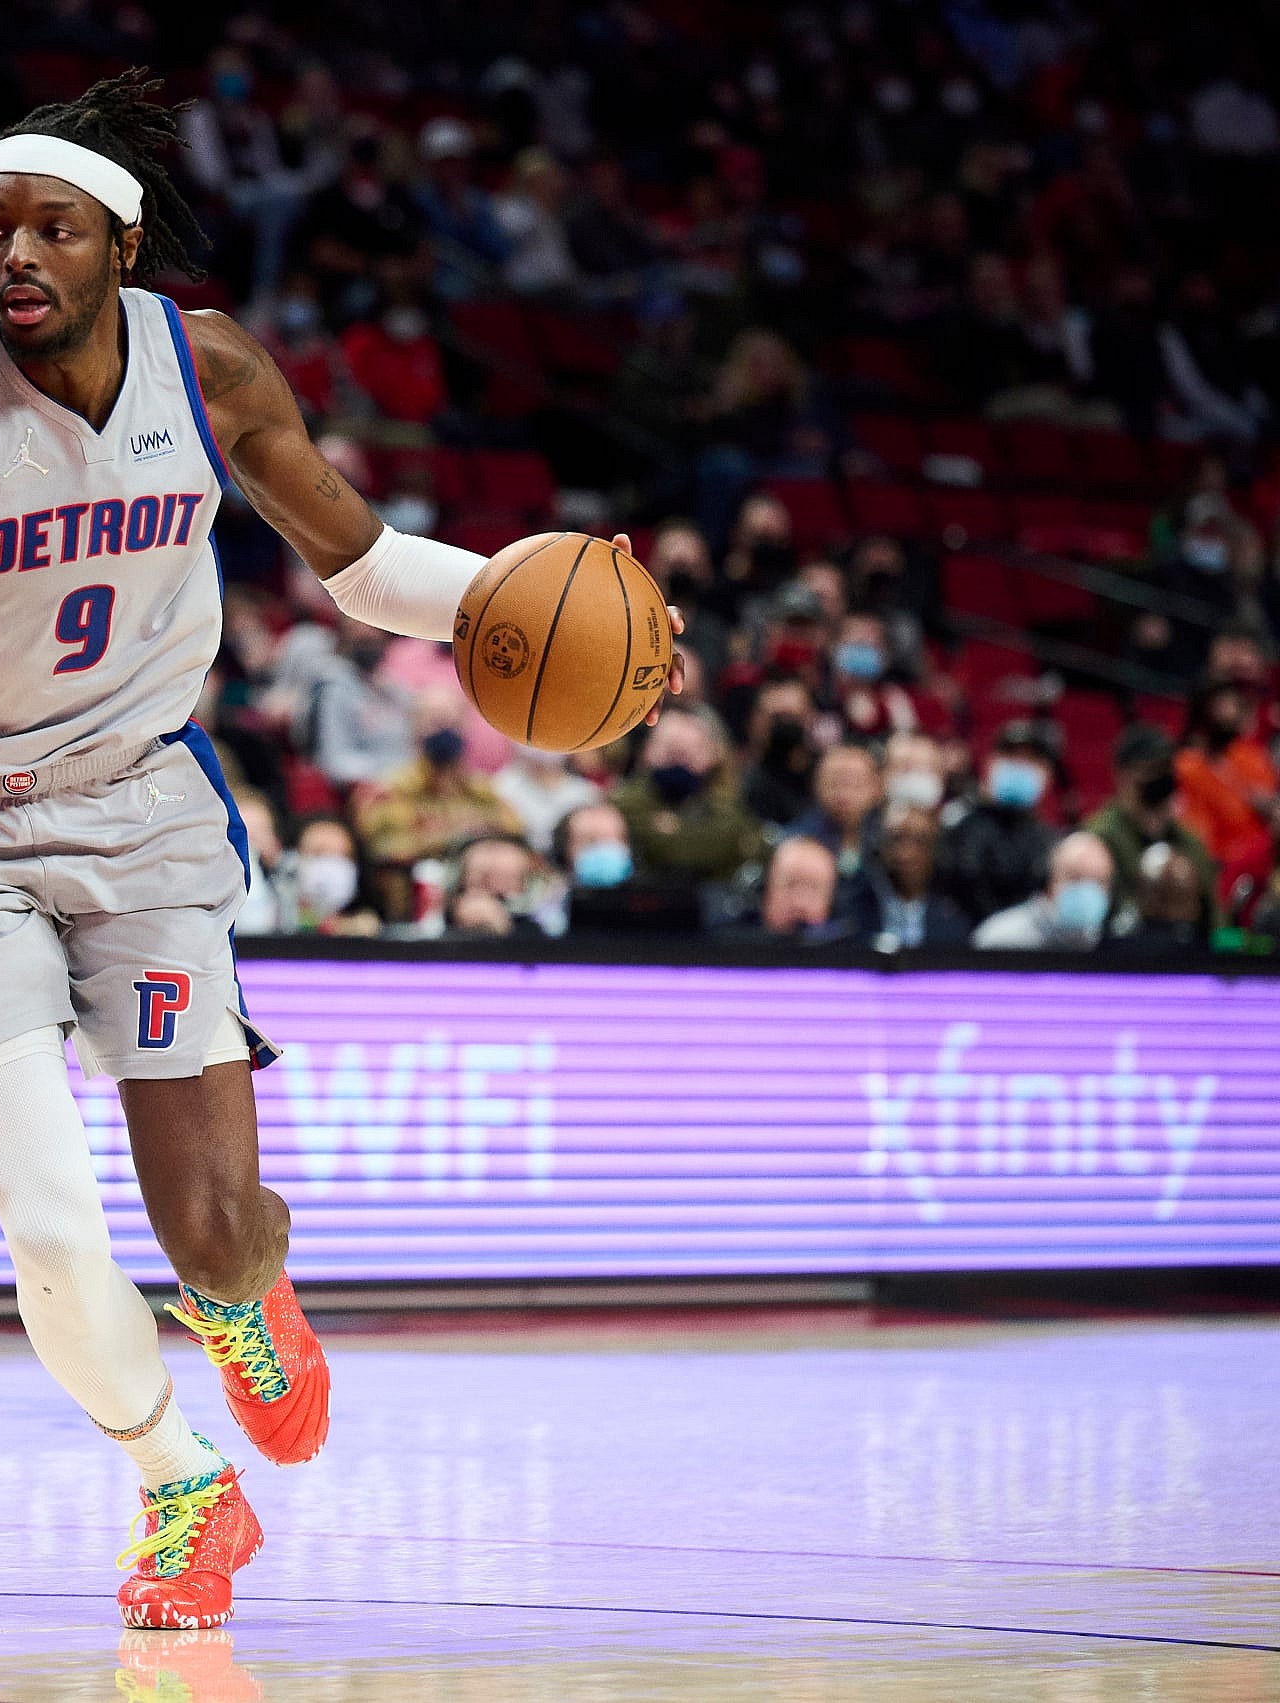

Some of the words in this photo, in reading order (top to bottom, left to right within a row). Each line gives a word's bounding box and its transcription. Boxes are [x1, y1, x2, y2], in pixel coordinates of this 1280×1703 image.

[129, 428, 173, 455] UWM
[52, 583, 116, 676] 9
[280, 1032, 558, 1197] WiFi
[859, 1021, 1217, 1222] xfinity
